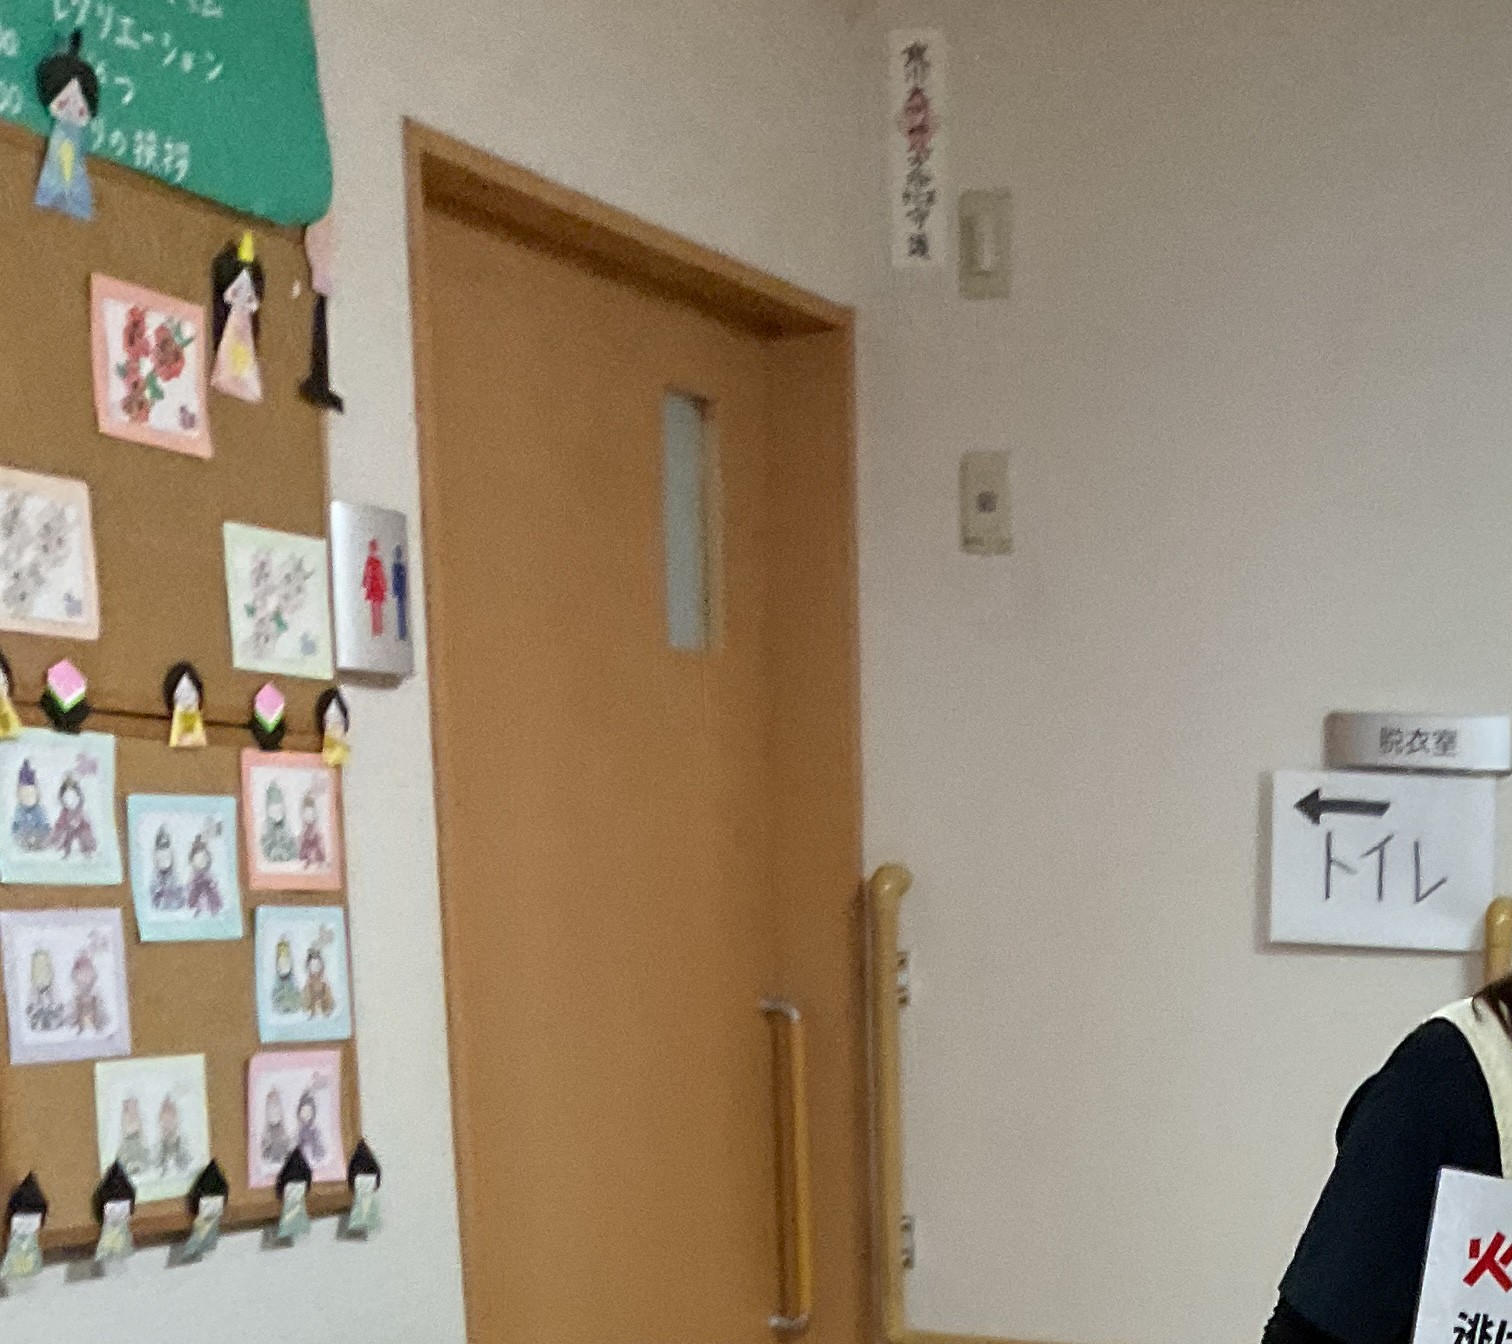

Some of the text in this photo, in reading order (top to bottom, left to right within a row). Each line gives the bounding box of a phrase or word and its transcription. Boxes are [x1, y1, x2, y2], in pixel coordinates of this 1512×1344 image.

[1379, 725, 1458, 757] 脱衣室
[1324, 830, 1449, 904] トイレ
